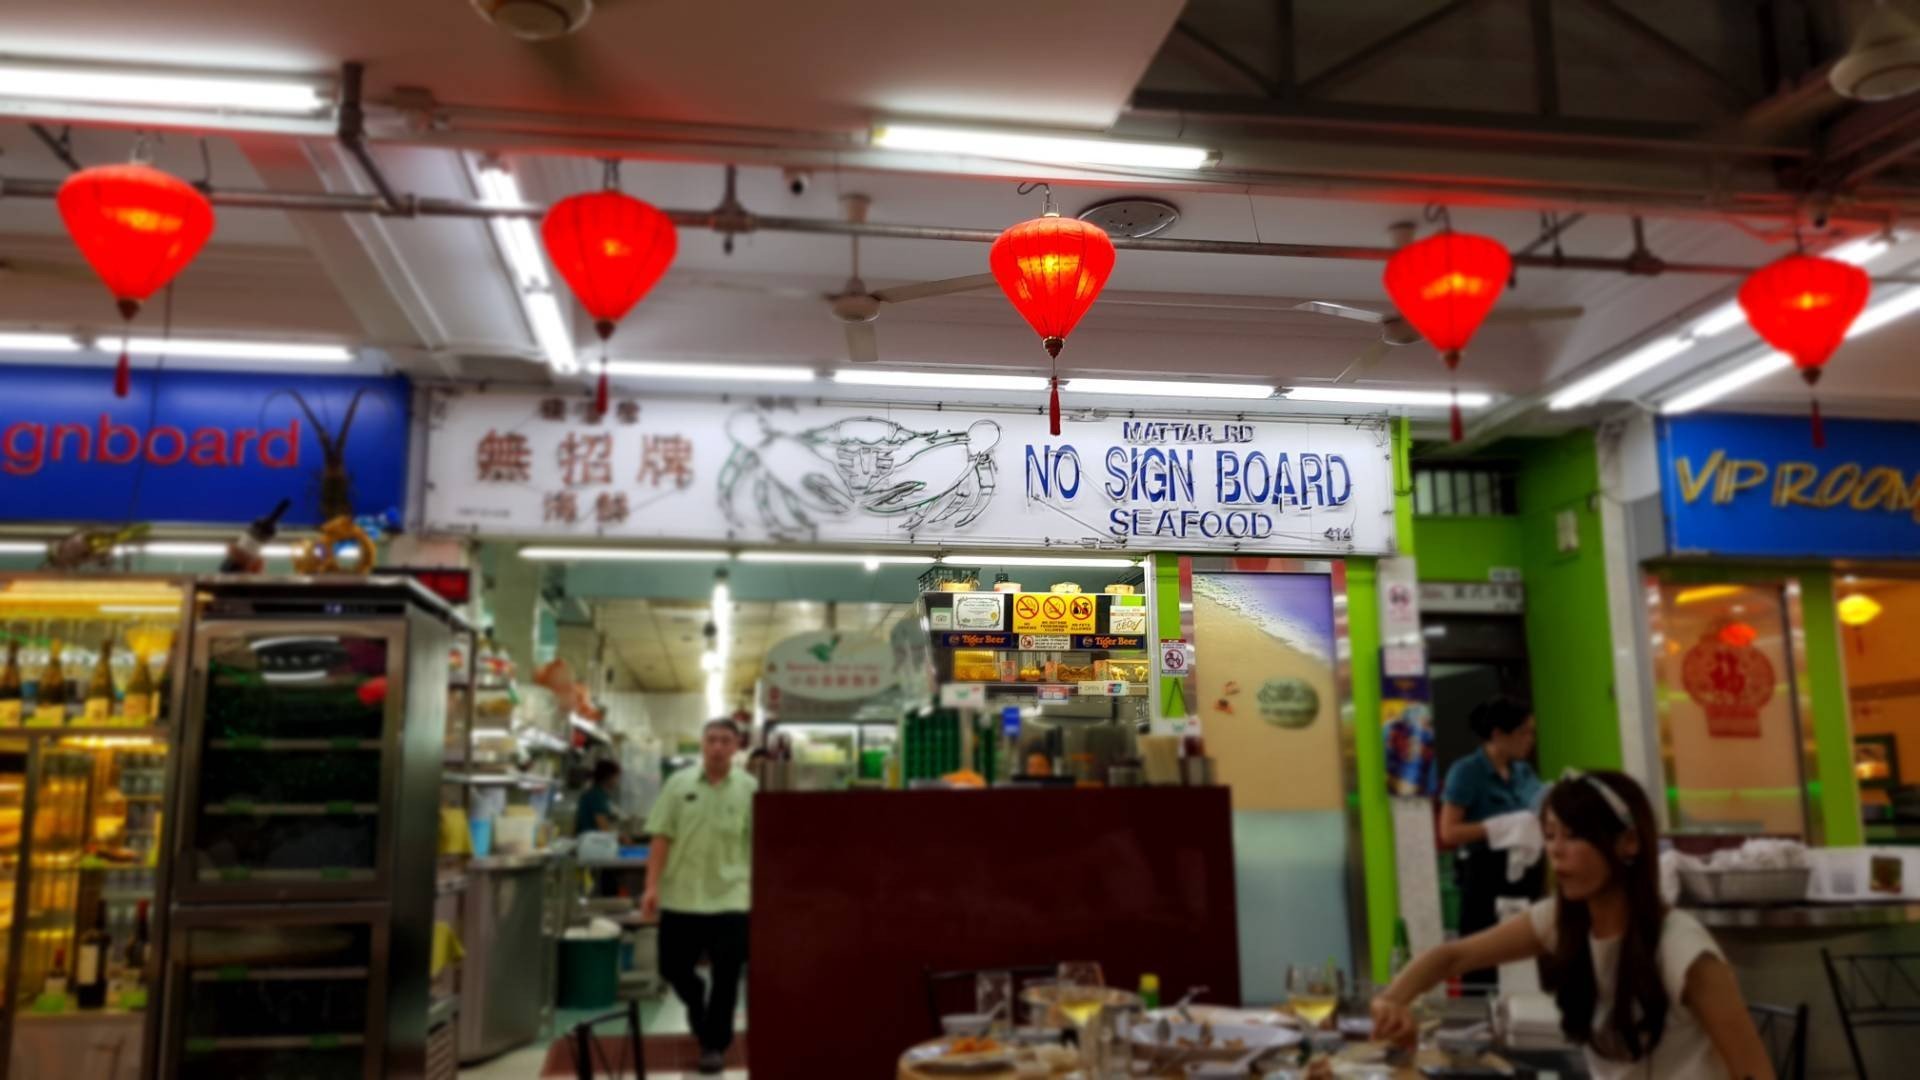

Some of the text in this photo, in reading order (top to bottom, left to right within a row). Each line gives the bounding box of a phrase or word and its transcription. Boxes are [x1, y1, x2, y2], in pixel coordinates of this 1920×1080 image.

[2, 413, 300, 475] gnboard
[1123, 421, 1254, 443] MATTAR RD
[1025, 444, 1352, 508] NO SIGN BOARD
[1675, 449, 1768, 504] VIP
[1109, 508, 1273, 538] SEAFOOD
[961, 633, 1005, 647] Tiger Beer
[1095, 636, 1138, 648] Tiger Beer
